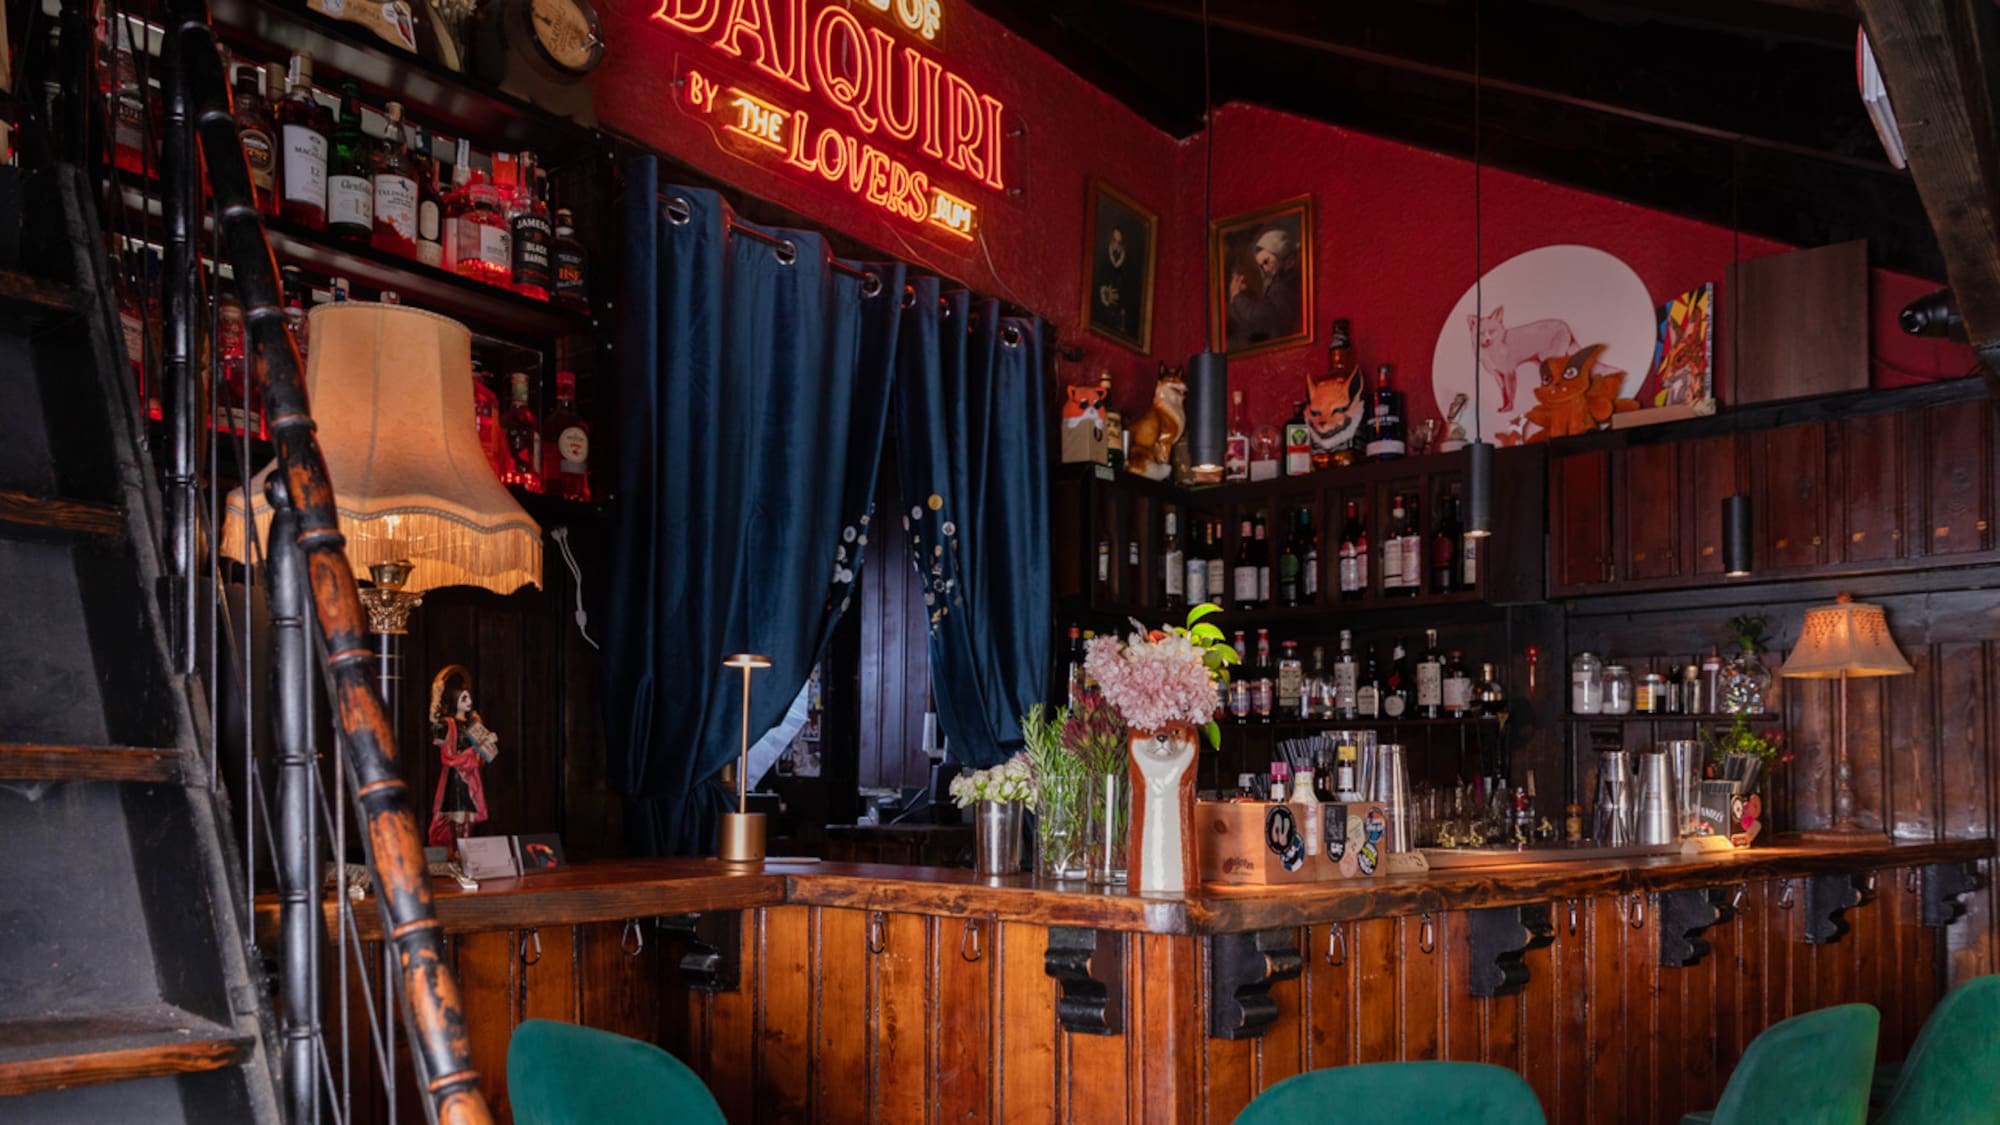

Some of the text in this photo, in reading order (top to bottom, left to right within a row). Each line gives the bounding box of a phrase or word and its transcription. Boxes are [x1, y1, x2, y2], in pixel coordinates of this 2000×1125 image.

[897, 0, 941, 40] OF
[687, 71, 718, 112] BY
[731, 98, 783, 142] THE
[785, 110, 930, 223] LOVERS
